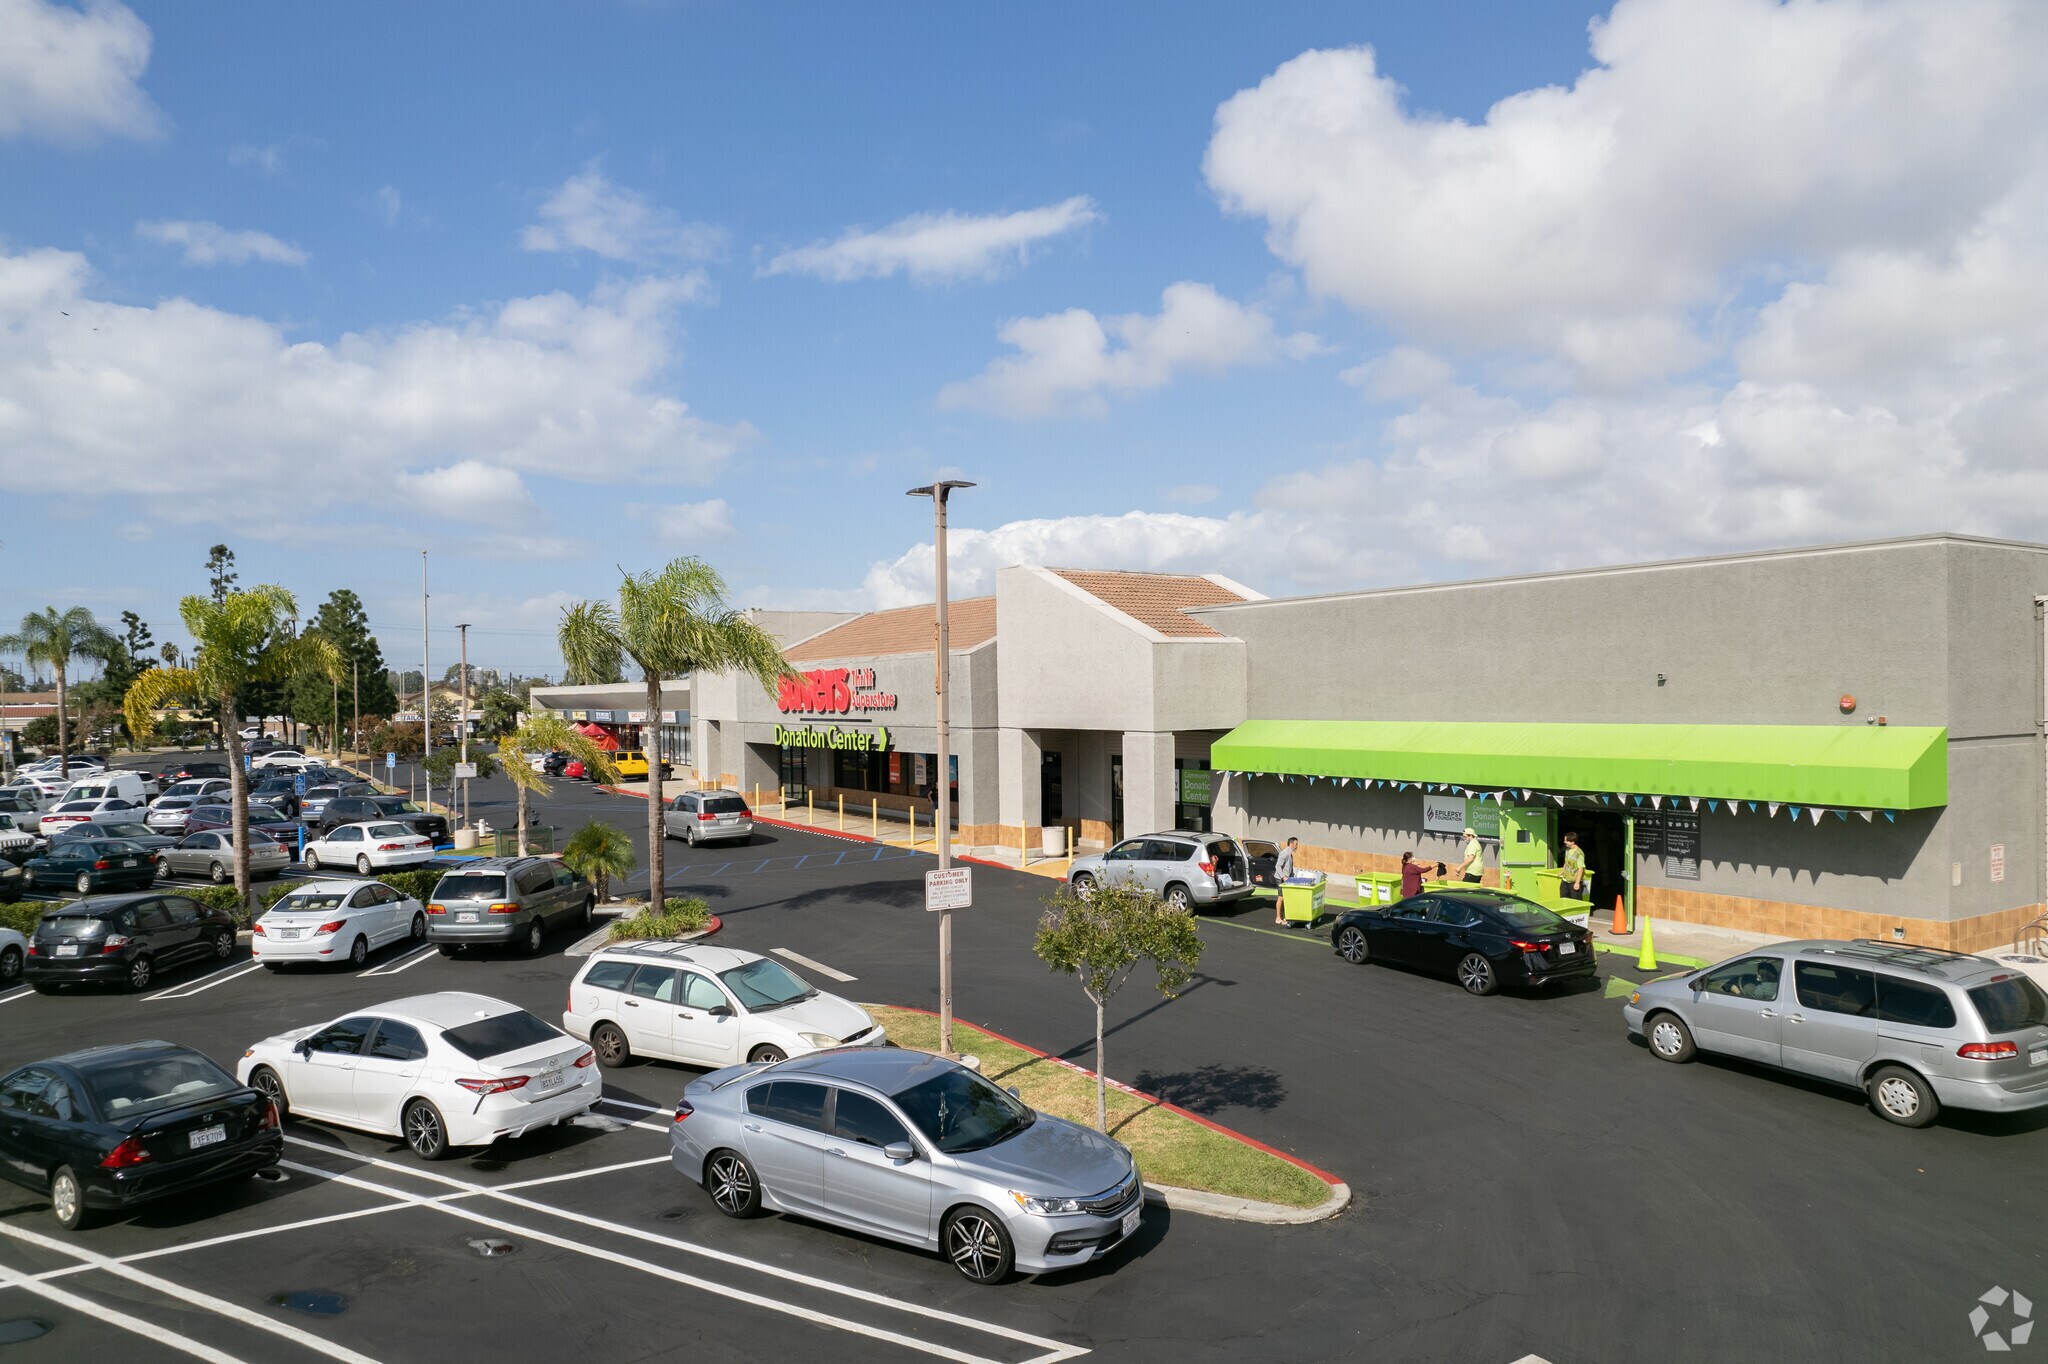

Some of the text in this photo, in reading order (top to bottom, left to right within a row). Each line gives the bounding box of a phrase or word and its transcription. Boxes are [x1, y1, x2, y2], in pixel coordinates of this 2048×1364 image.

[851, 668, 873, 687] Thrift
[851, 690, 896, 711] Superstore
[774, 724, 873, 751] Donation Center
[1184, 790, 1210, 801] Center
[1435, 810, 1462, 818] EPILEPSY
[1472, 820, 1498, 829] Center
[933, 871, 964, 879] CUSTOMER
[929, 879, 953, 887] PARKING
